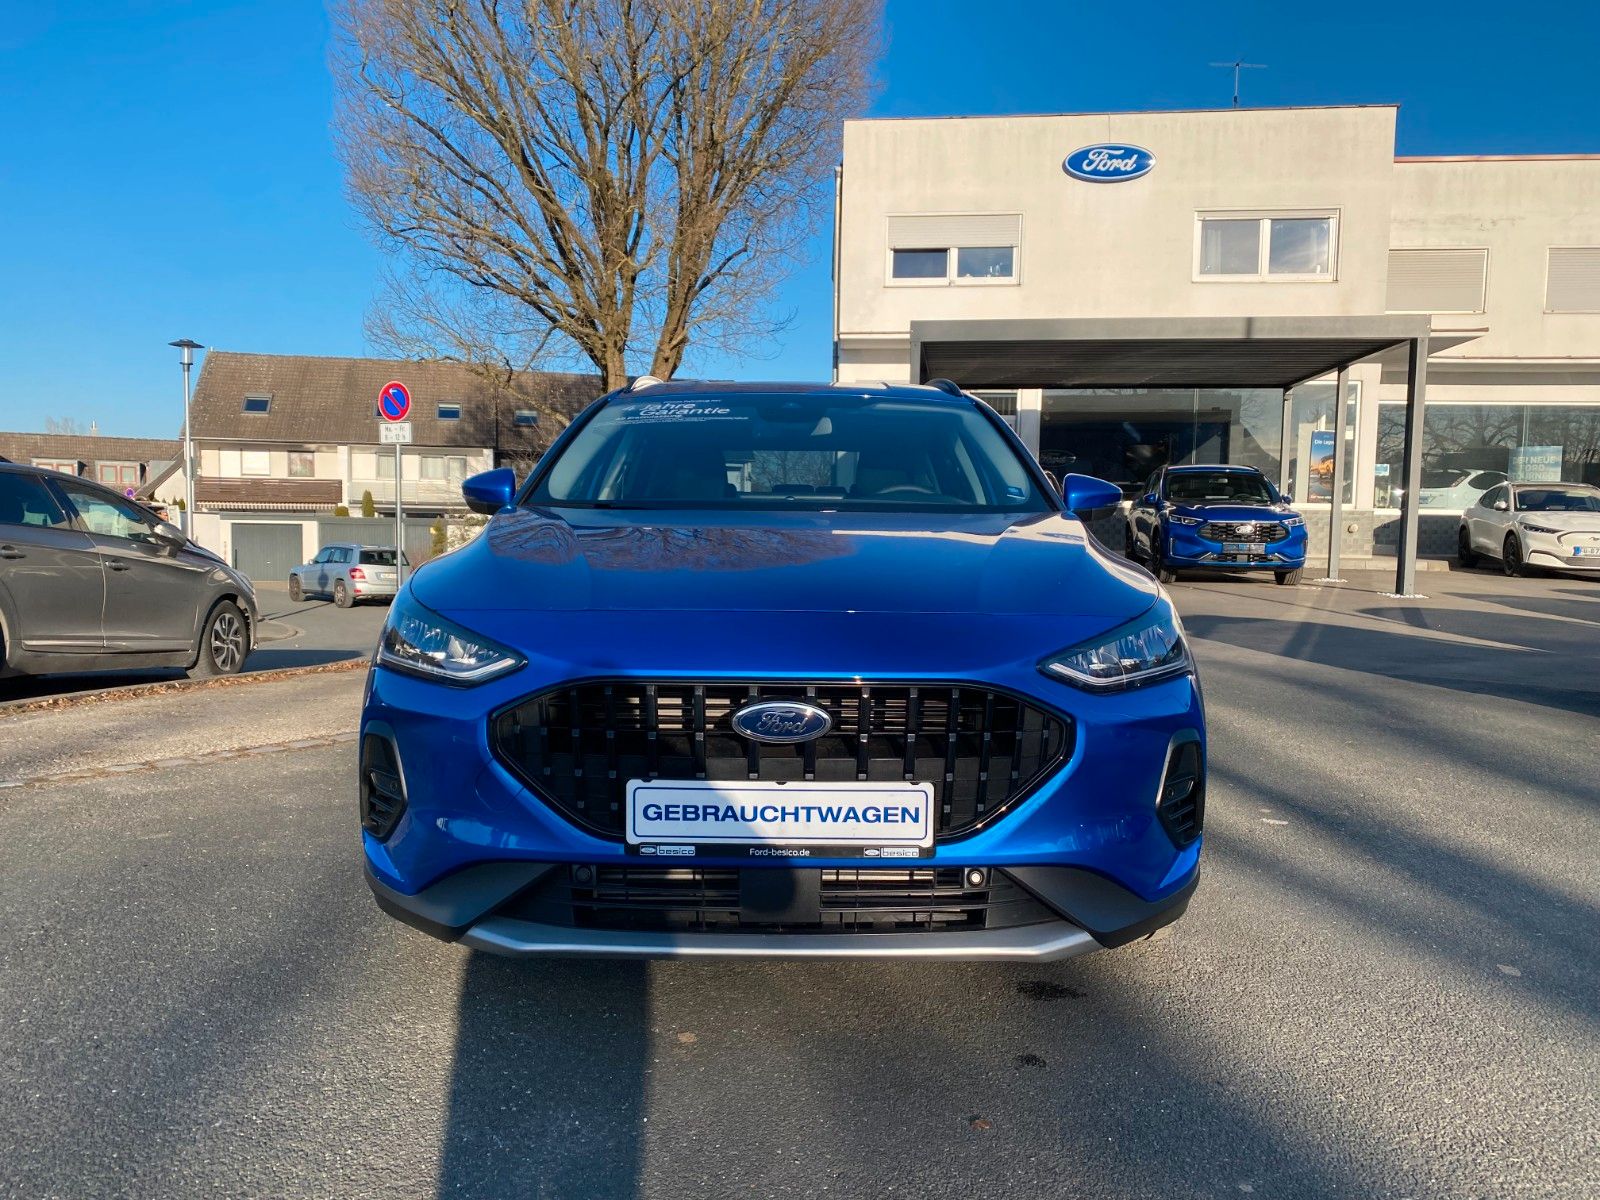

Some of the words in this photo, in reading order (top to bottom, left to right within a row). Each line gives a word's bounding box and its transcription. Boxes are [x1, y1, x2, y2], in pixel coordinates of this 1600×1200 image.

[1082, 148, 1138, 171] Ford
[639, 407, 731, 416] Garantie
[757, 710, 808, 734] Ford
[642, 803, 920, 824] GEBRAUCHTWAGEN
[658, 845, 695, 855] besico
[749, 847, 810, 857] Ford-besico.de
[882, 847, 918, 857] besico
